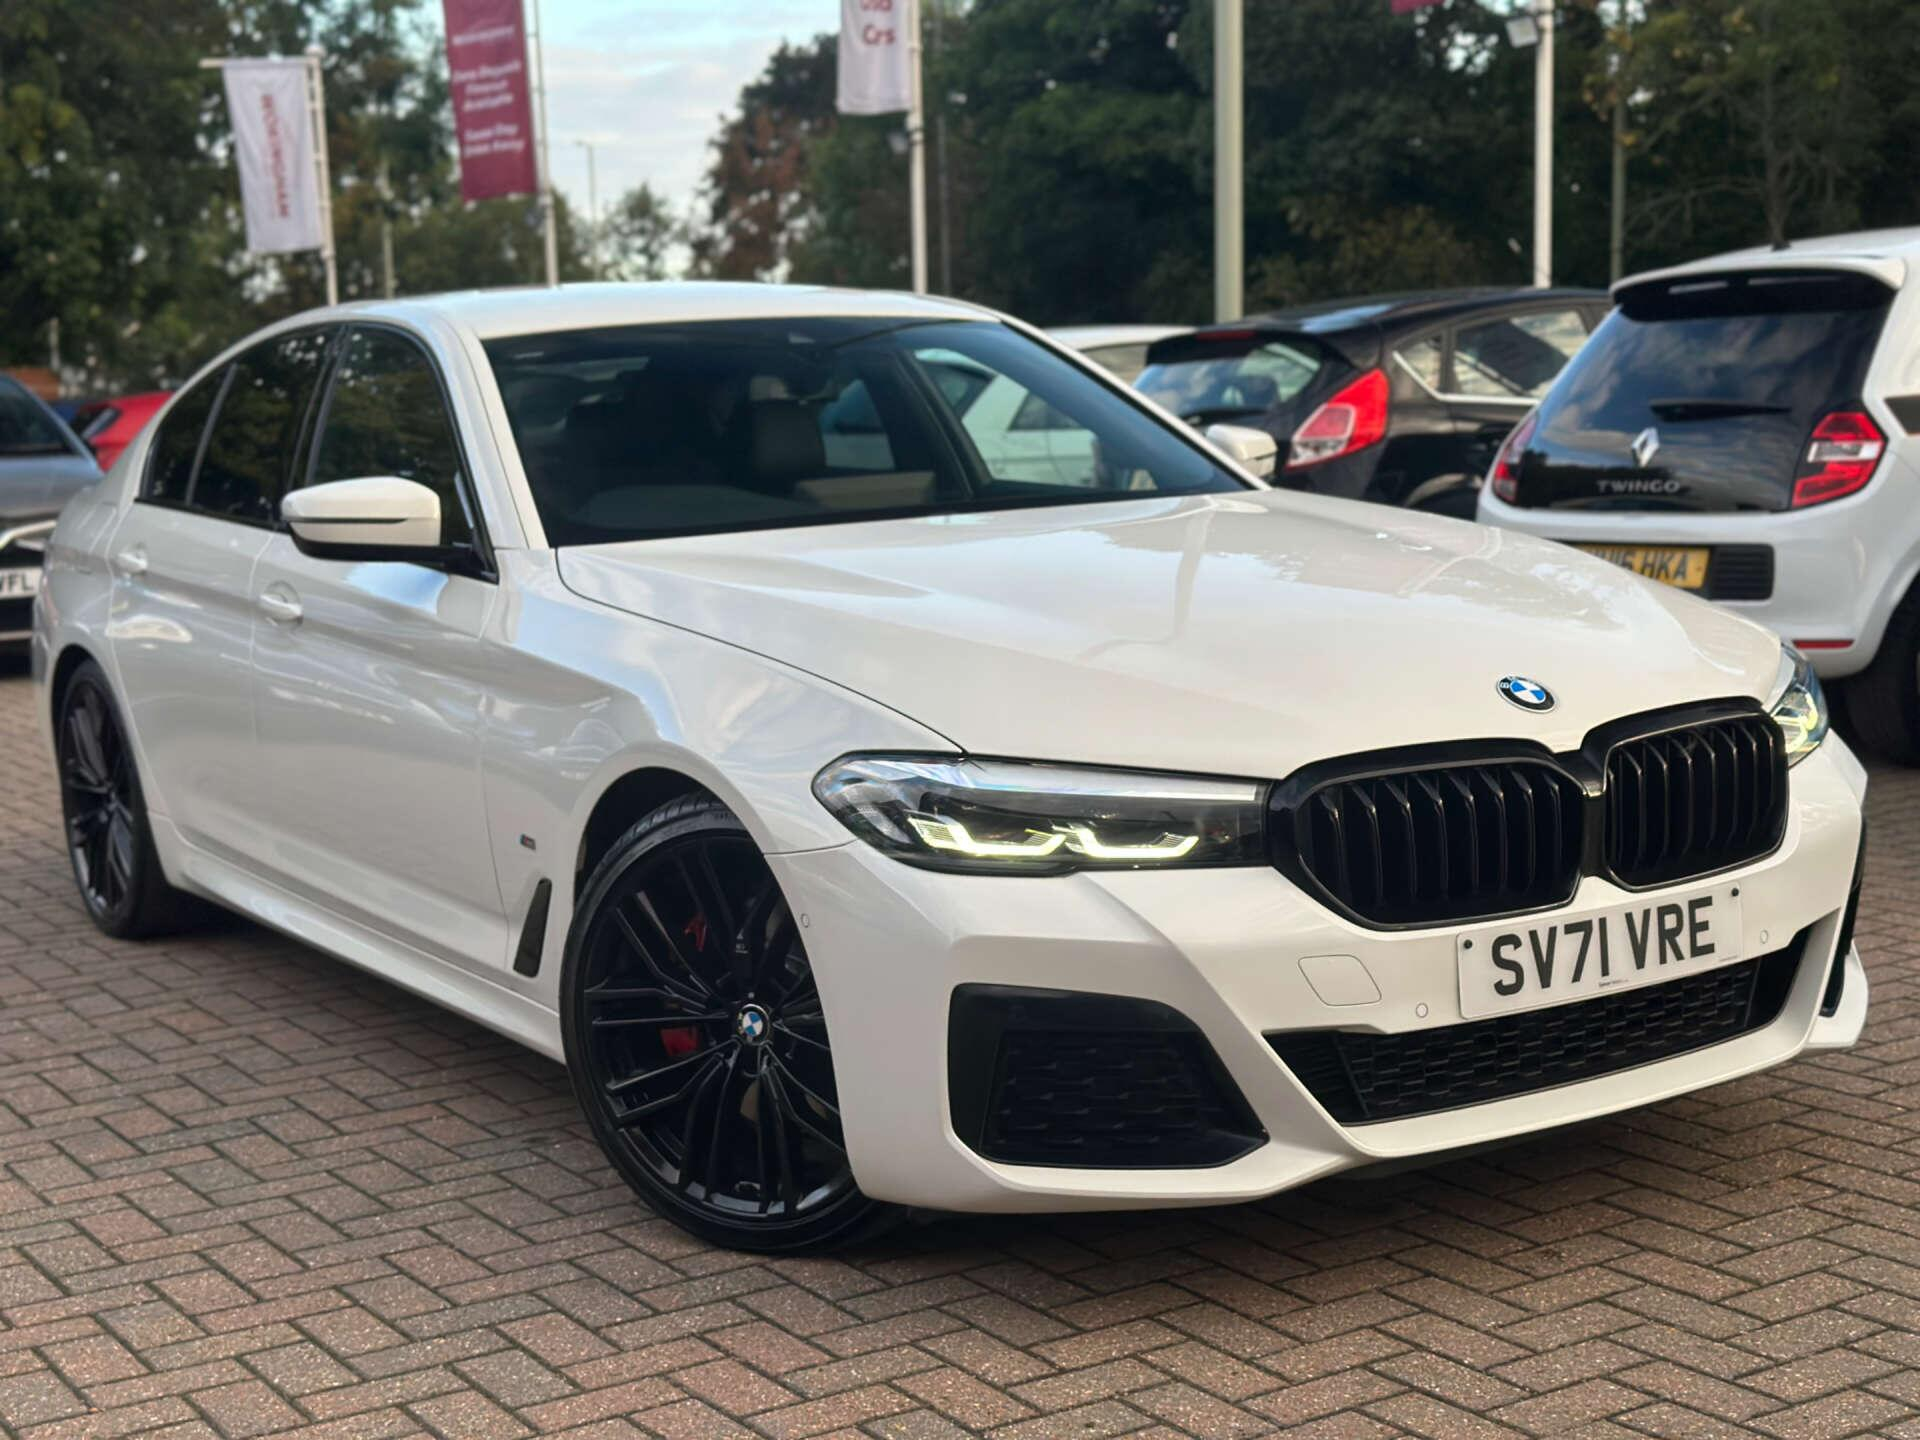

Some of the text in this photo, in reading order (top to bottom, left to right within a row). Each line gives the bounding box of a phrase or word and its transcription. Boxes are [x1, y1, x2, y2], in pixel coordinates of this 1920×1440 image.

[1597, 480, 1680, 493] TWINGO
[1491, 895, 1716, 997] SV71 VRE
